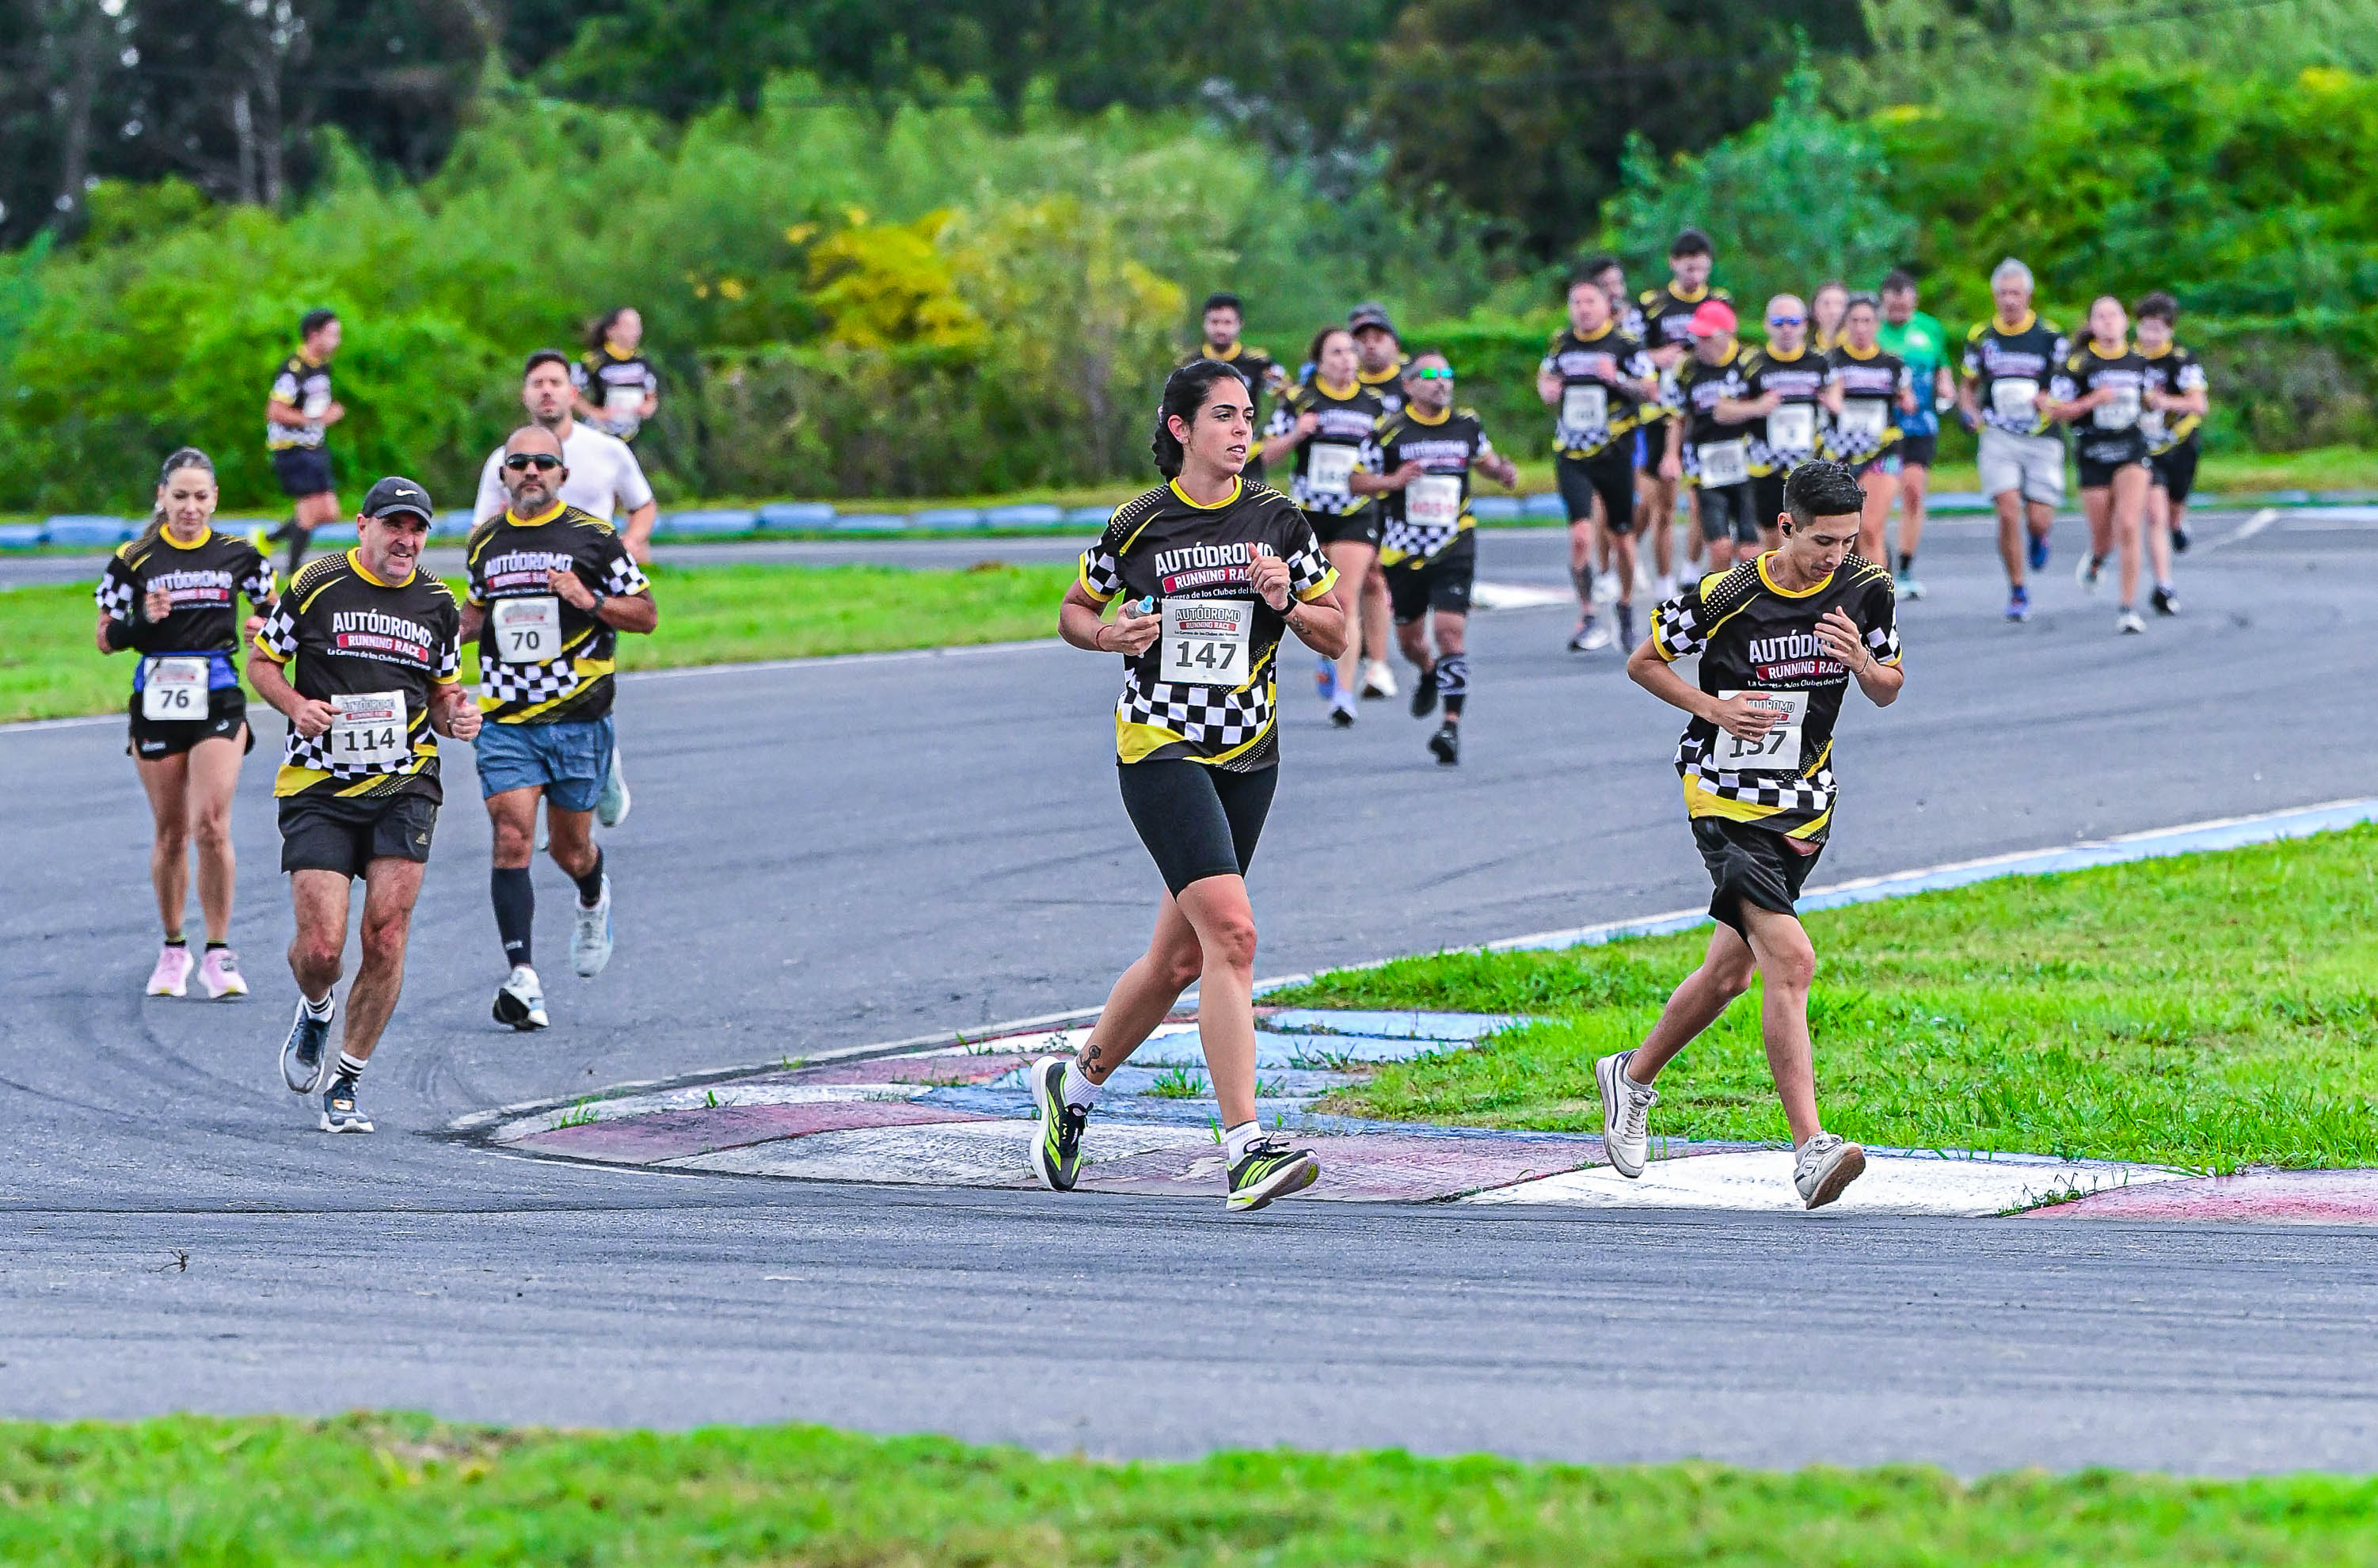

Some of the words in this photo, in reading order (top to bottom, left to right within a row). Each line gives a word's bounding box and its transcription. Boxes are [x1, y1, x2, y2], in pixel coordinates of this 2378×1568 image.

[1155, 541, 1273, 577] AUTÓDROMO
[1174, 570, 1226, 589] RUNNING
[1229, 568, 1252, 581] RA
[1201, 589, 1212, 598] los
[1212, 587, 1237, 597] Clubes
[1238, 586, 1249, 595] del
[1175, 603, 1241, 622] AUTÓDROMO
[332, 607, 433, 649] AUTÓDROMO
[348, 634, 394, 650] RUNNING
[394, 640, 420, 659] RACE
[511, 630, 540, 651] 70
[1748, 629, 1832, 663] AUTÓDR
[1175, 640, 1237, 670] 147
[1767, 660, 1816, 679] RUNNING
[1818, 660, 1844, 674] RACE
[161, 689, 189, 710] 76
[344, 727, 396, 752] 114
